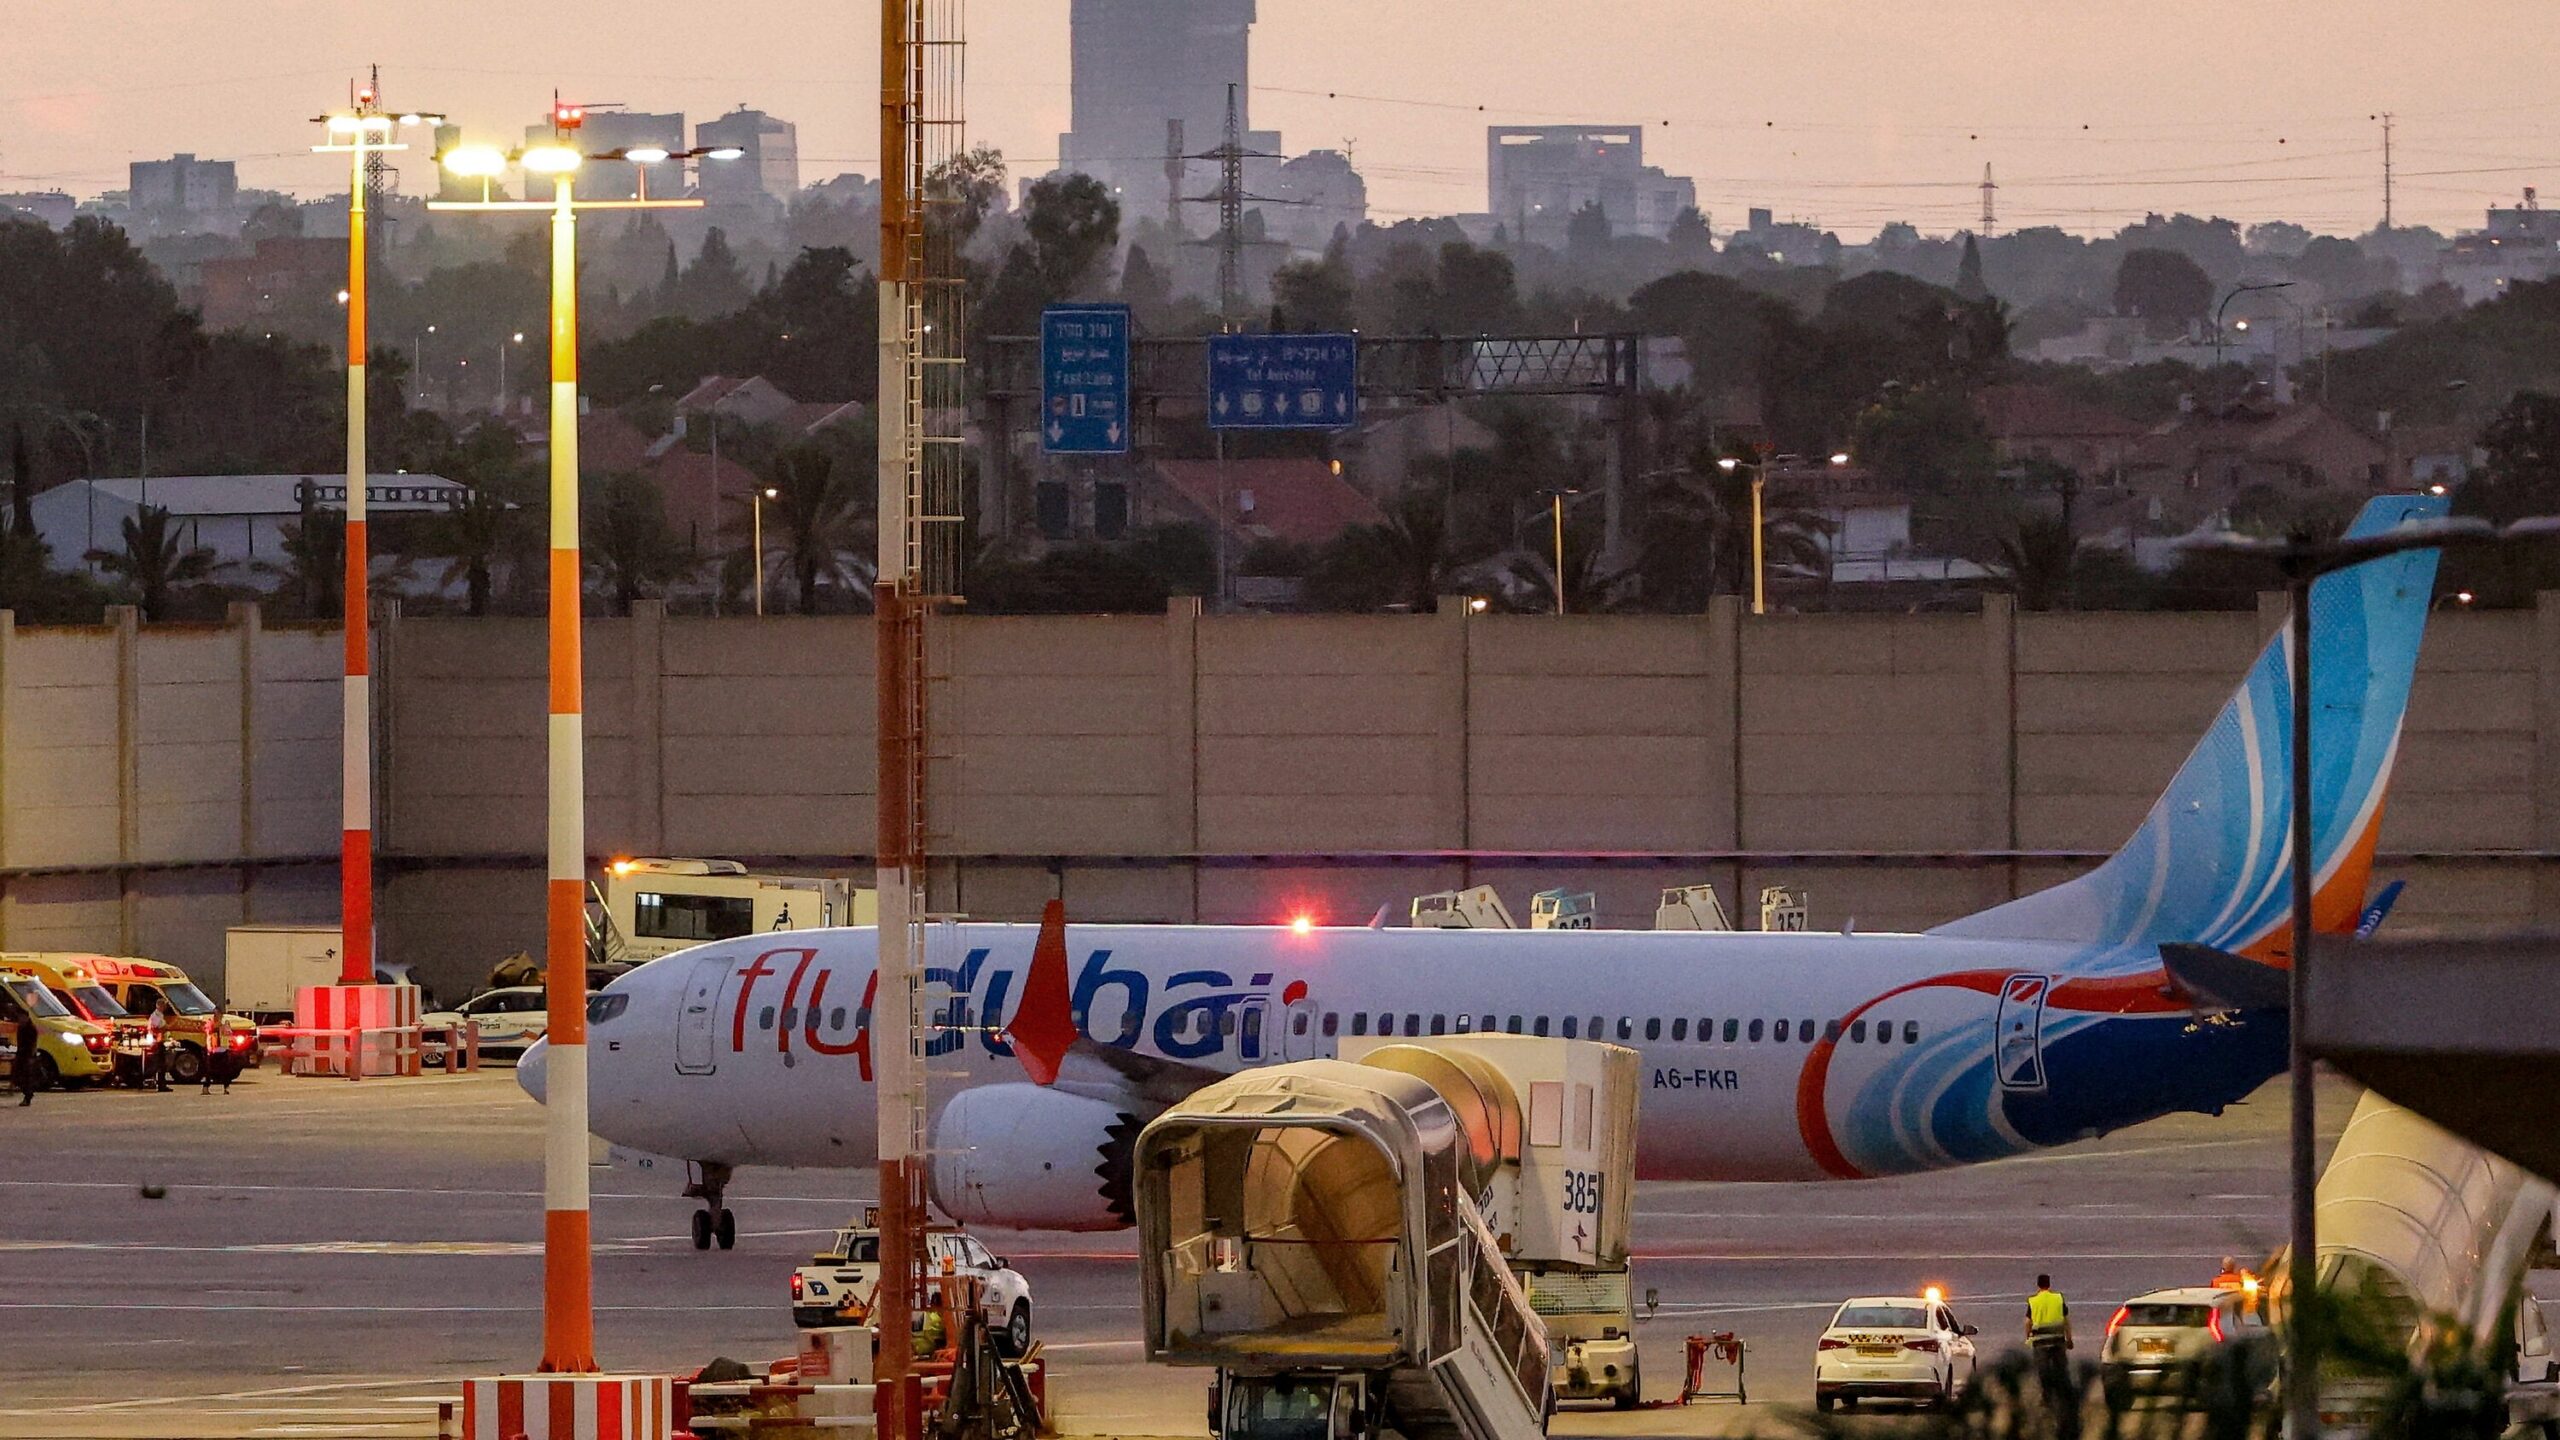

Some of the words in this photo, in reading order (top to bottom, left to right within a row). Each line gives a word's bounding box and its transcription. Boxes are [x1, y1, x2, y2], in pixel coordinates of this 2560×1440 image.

[733, 947, 1300, 1081] flydubai
[1653, 1067, 1738, 1091] A6-FKR
[1563, 1169, 1598, 1214] 385
